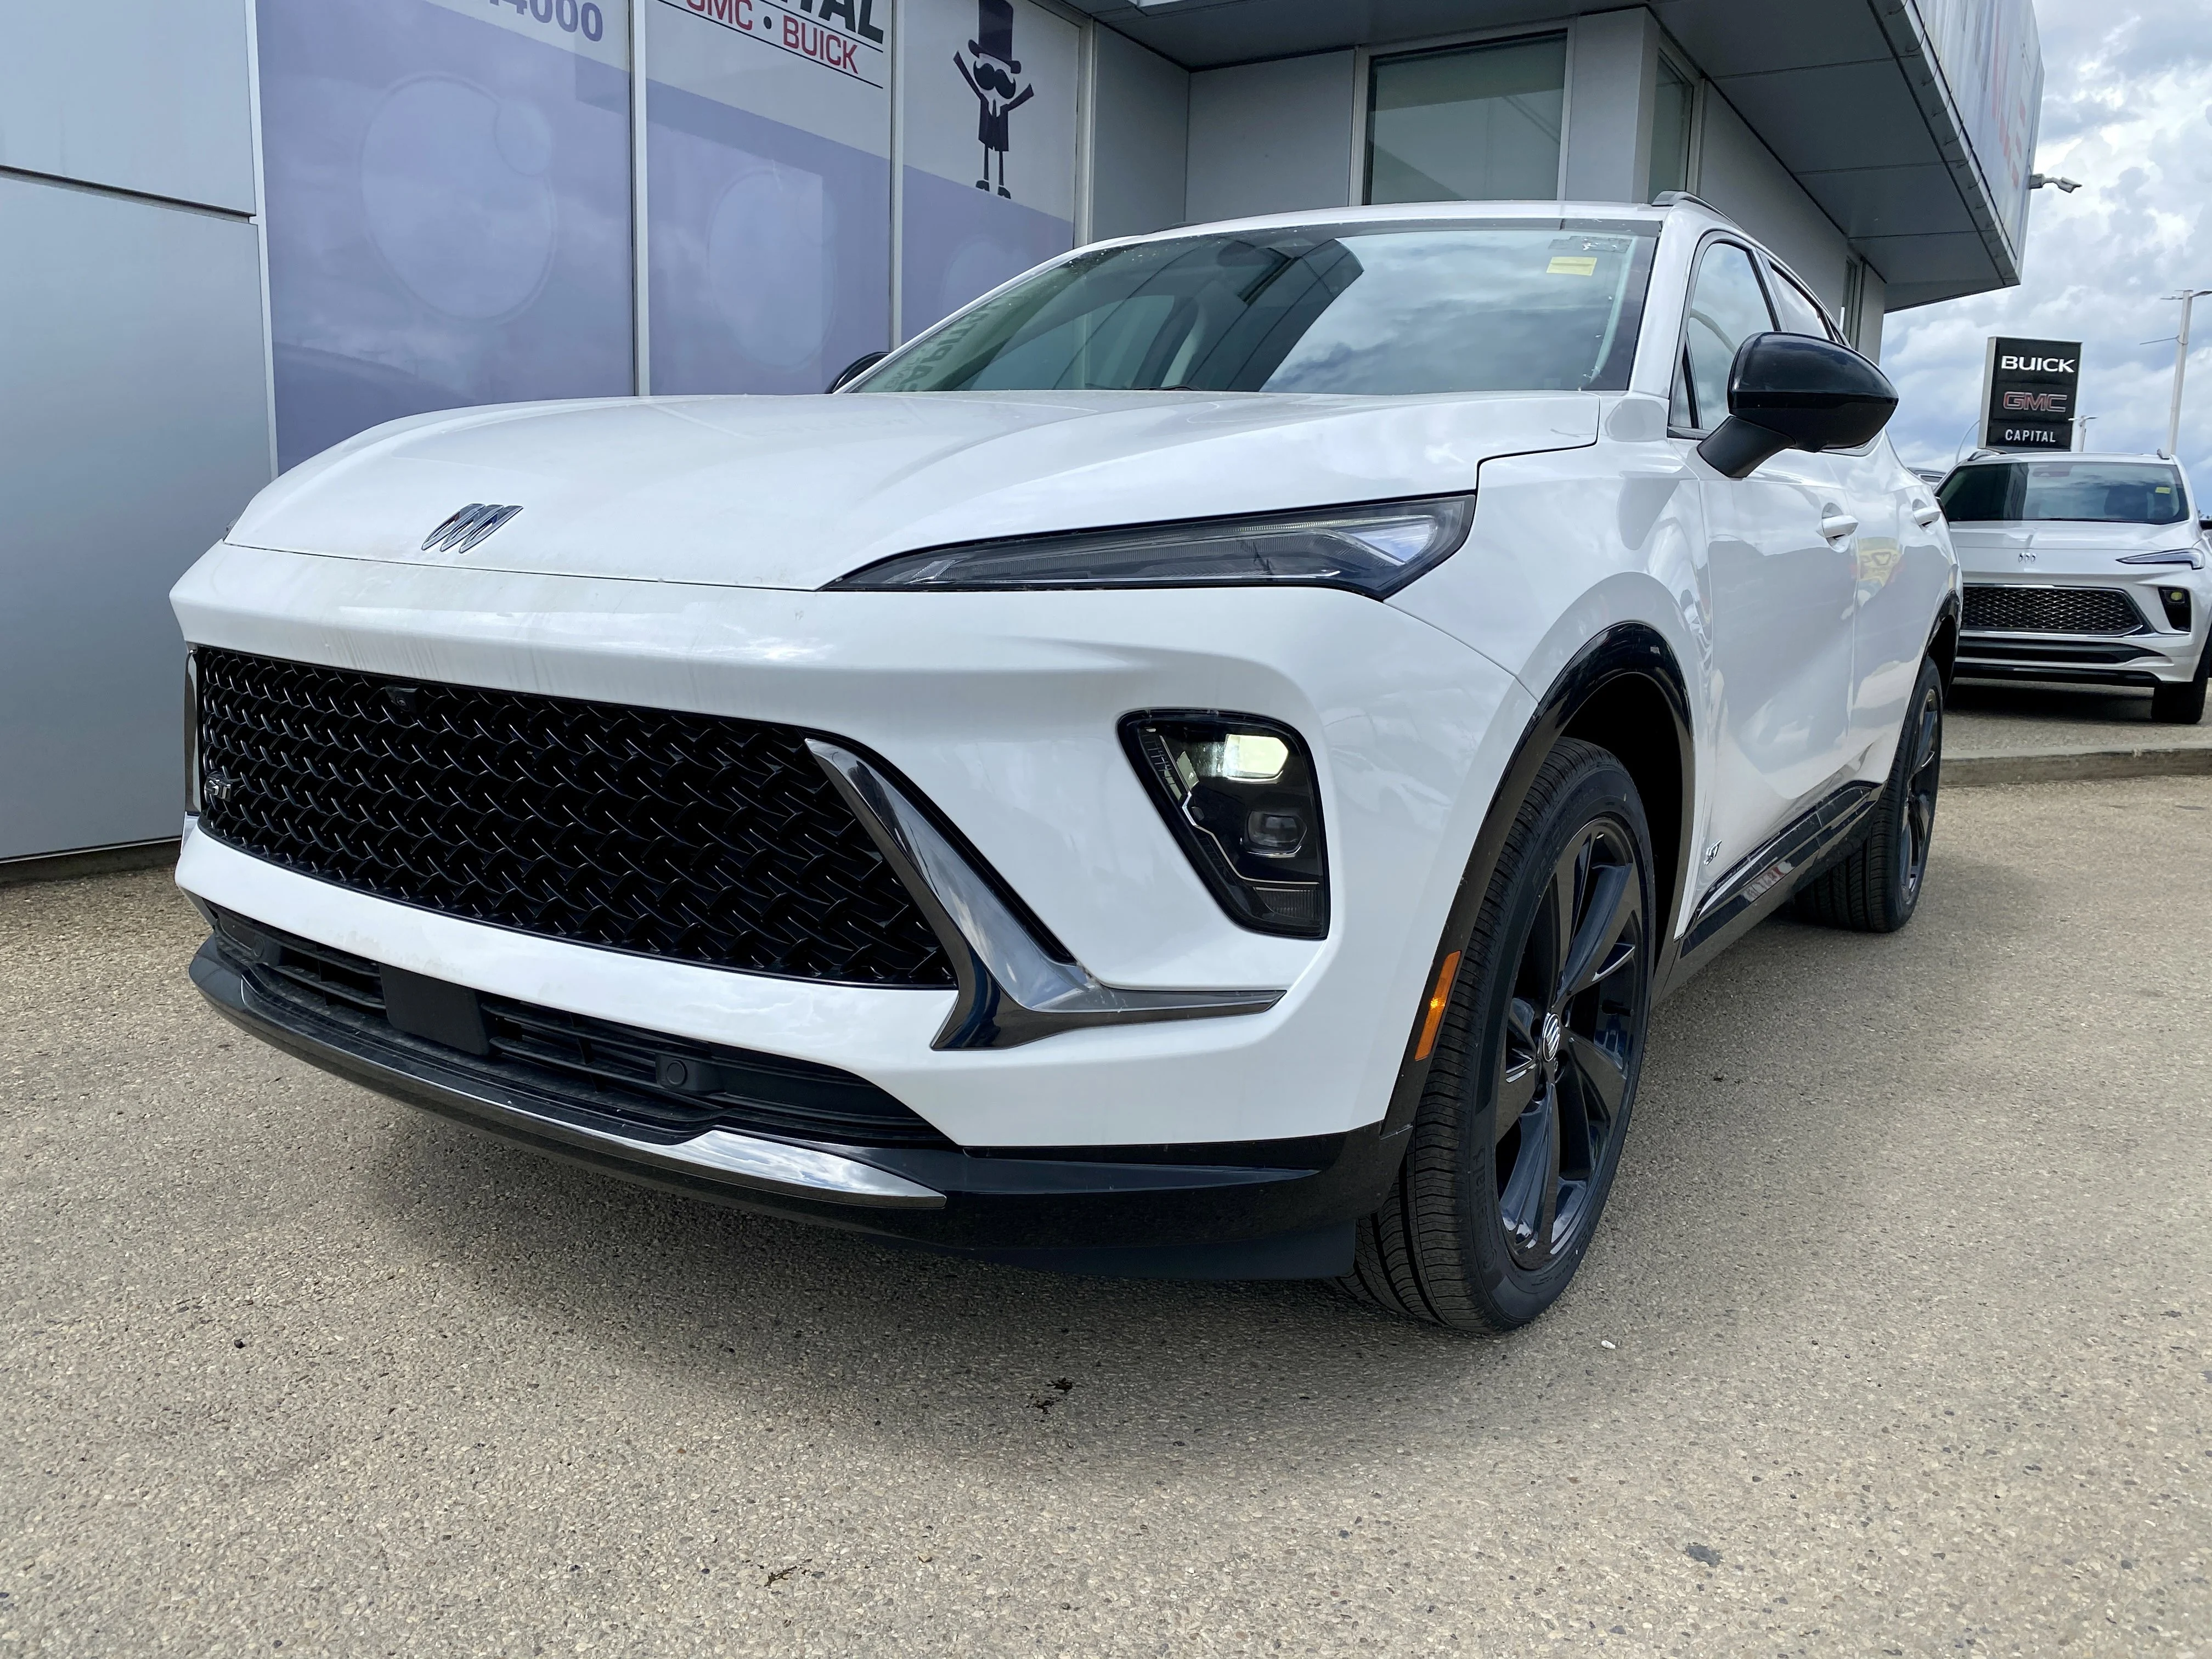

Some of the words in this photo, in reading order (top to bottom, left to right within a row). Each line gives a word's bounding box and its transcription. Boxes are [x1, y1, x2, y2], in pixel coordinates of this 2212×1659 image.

[783, 15, 859, 75] BUICK
[2001, 356, 2076, 373] BUICK
[2003, 391, 2068, 413] GMC
[2005, 429, 2057, 443] CAPITAL
